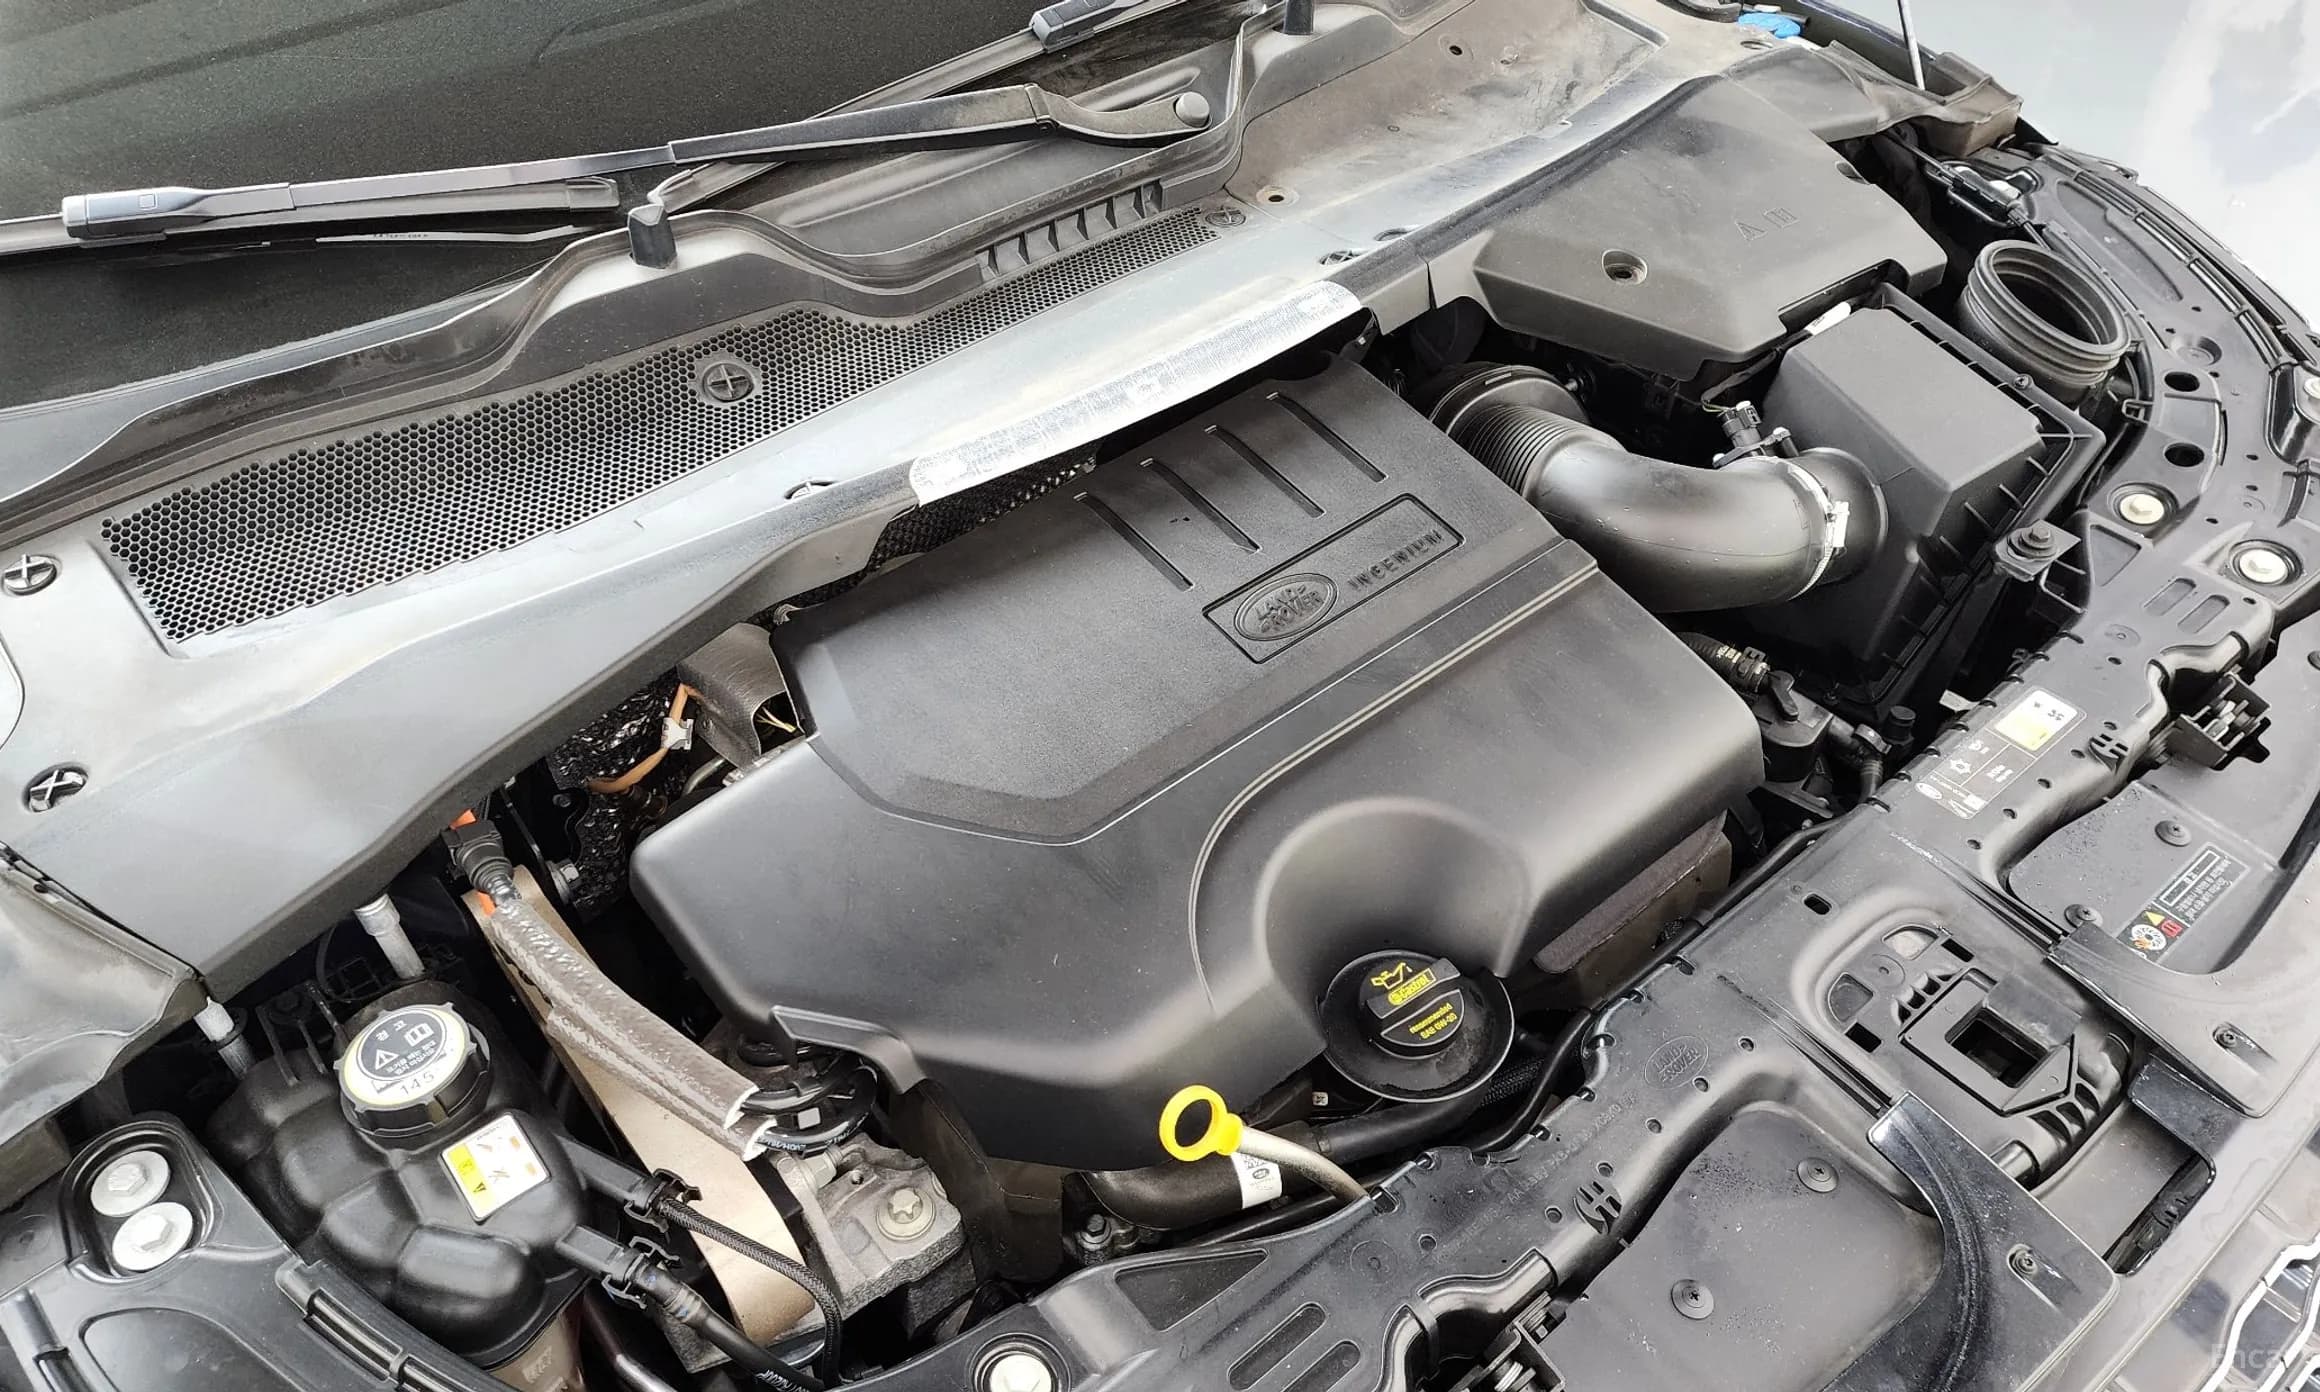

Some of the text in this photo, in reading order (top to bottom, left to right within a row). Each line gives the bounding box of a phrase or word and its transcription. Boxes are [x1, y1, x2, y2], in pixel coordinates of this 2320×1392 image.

[1346, 529, 1443, 591] INGENIUM
[1652, 1045, 1681, 1072] LAND
[1664, 1046, 1701, 1078] ROVER
[400, 1071, 434, 1095] 145
